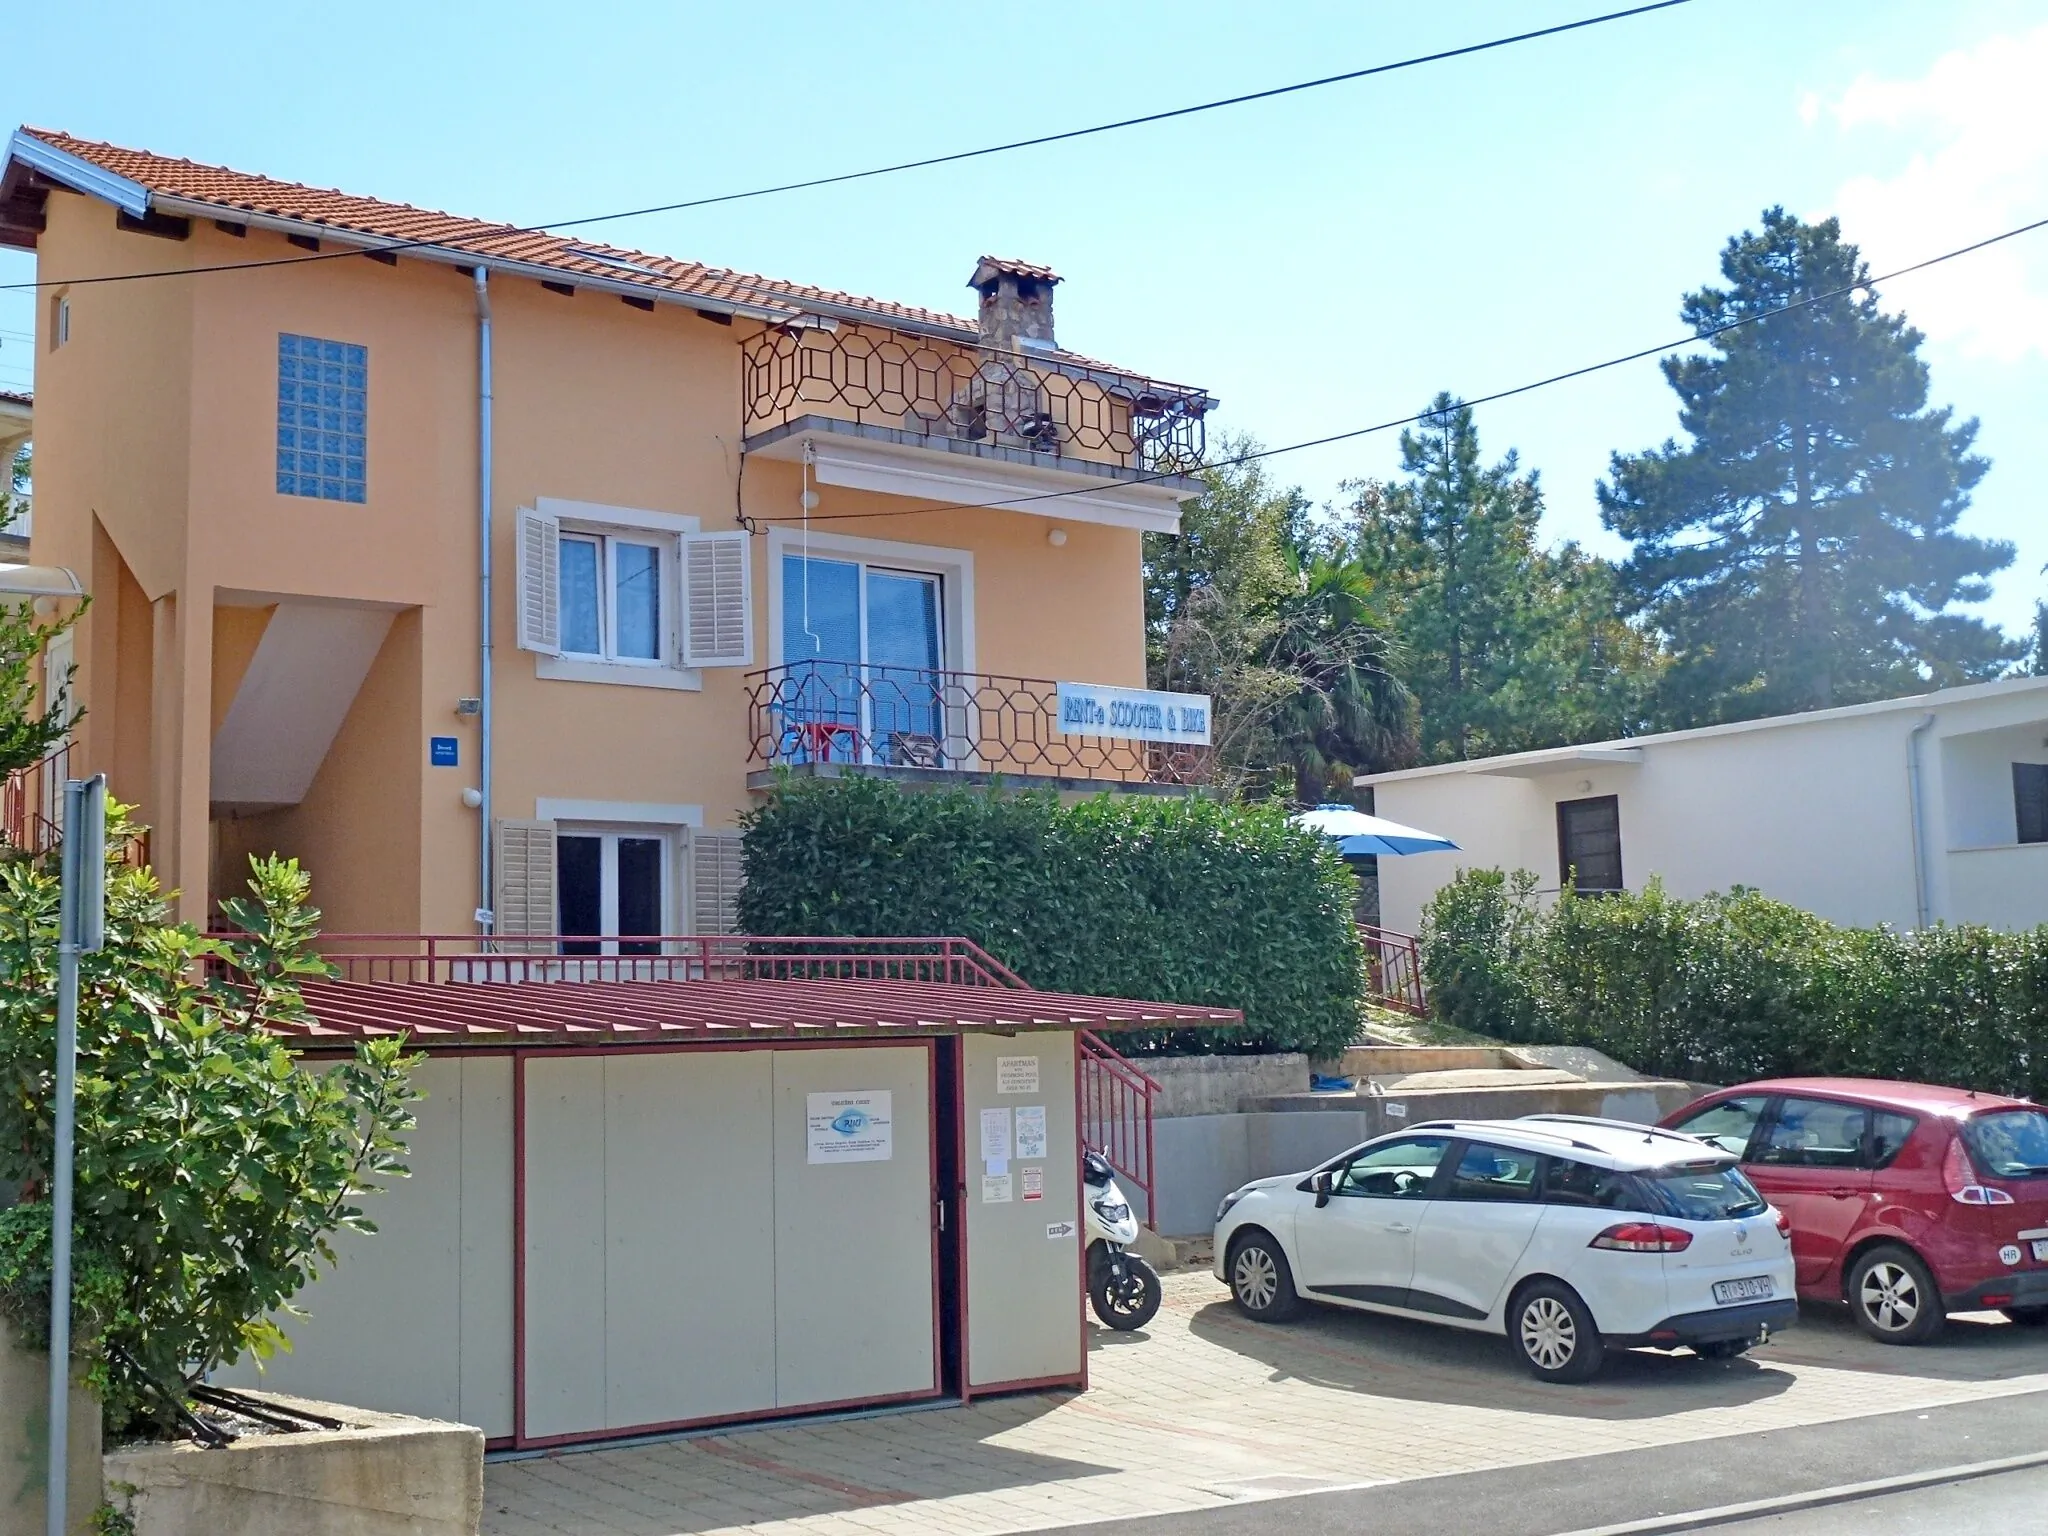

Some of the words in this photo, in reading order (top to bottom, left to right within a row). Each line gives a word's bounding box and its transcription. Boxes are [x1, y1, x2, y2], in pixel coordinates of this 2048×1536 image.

[1064, 696, 1104, 725] RENT-a
[1109, 700, 1162, 729] SCOOTER
[1167, 706, 1176, 731] &
[1181, 706, 1206, 733] BIKE
[1730, 1248, 1752, 1256] CLIO
[2003, 1249, 2017, 1260] HR
